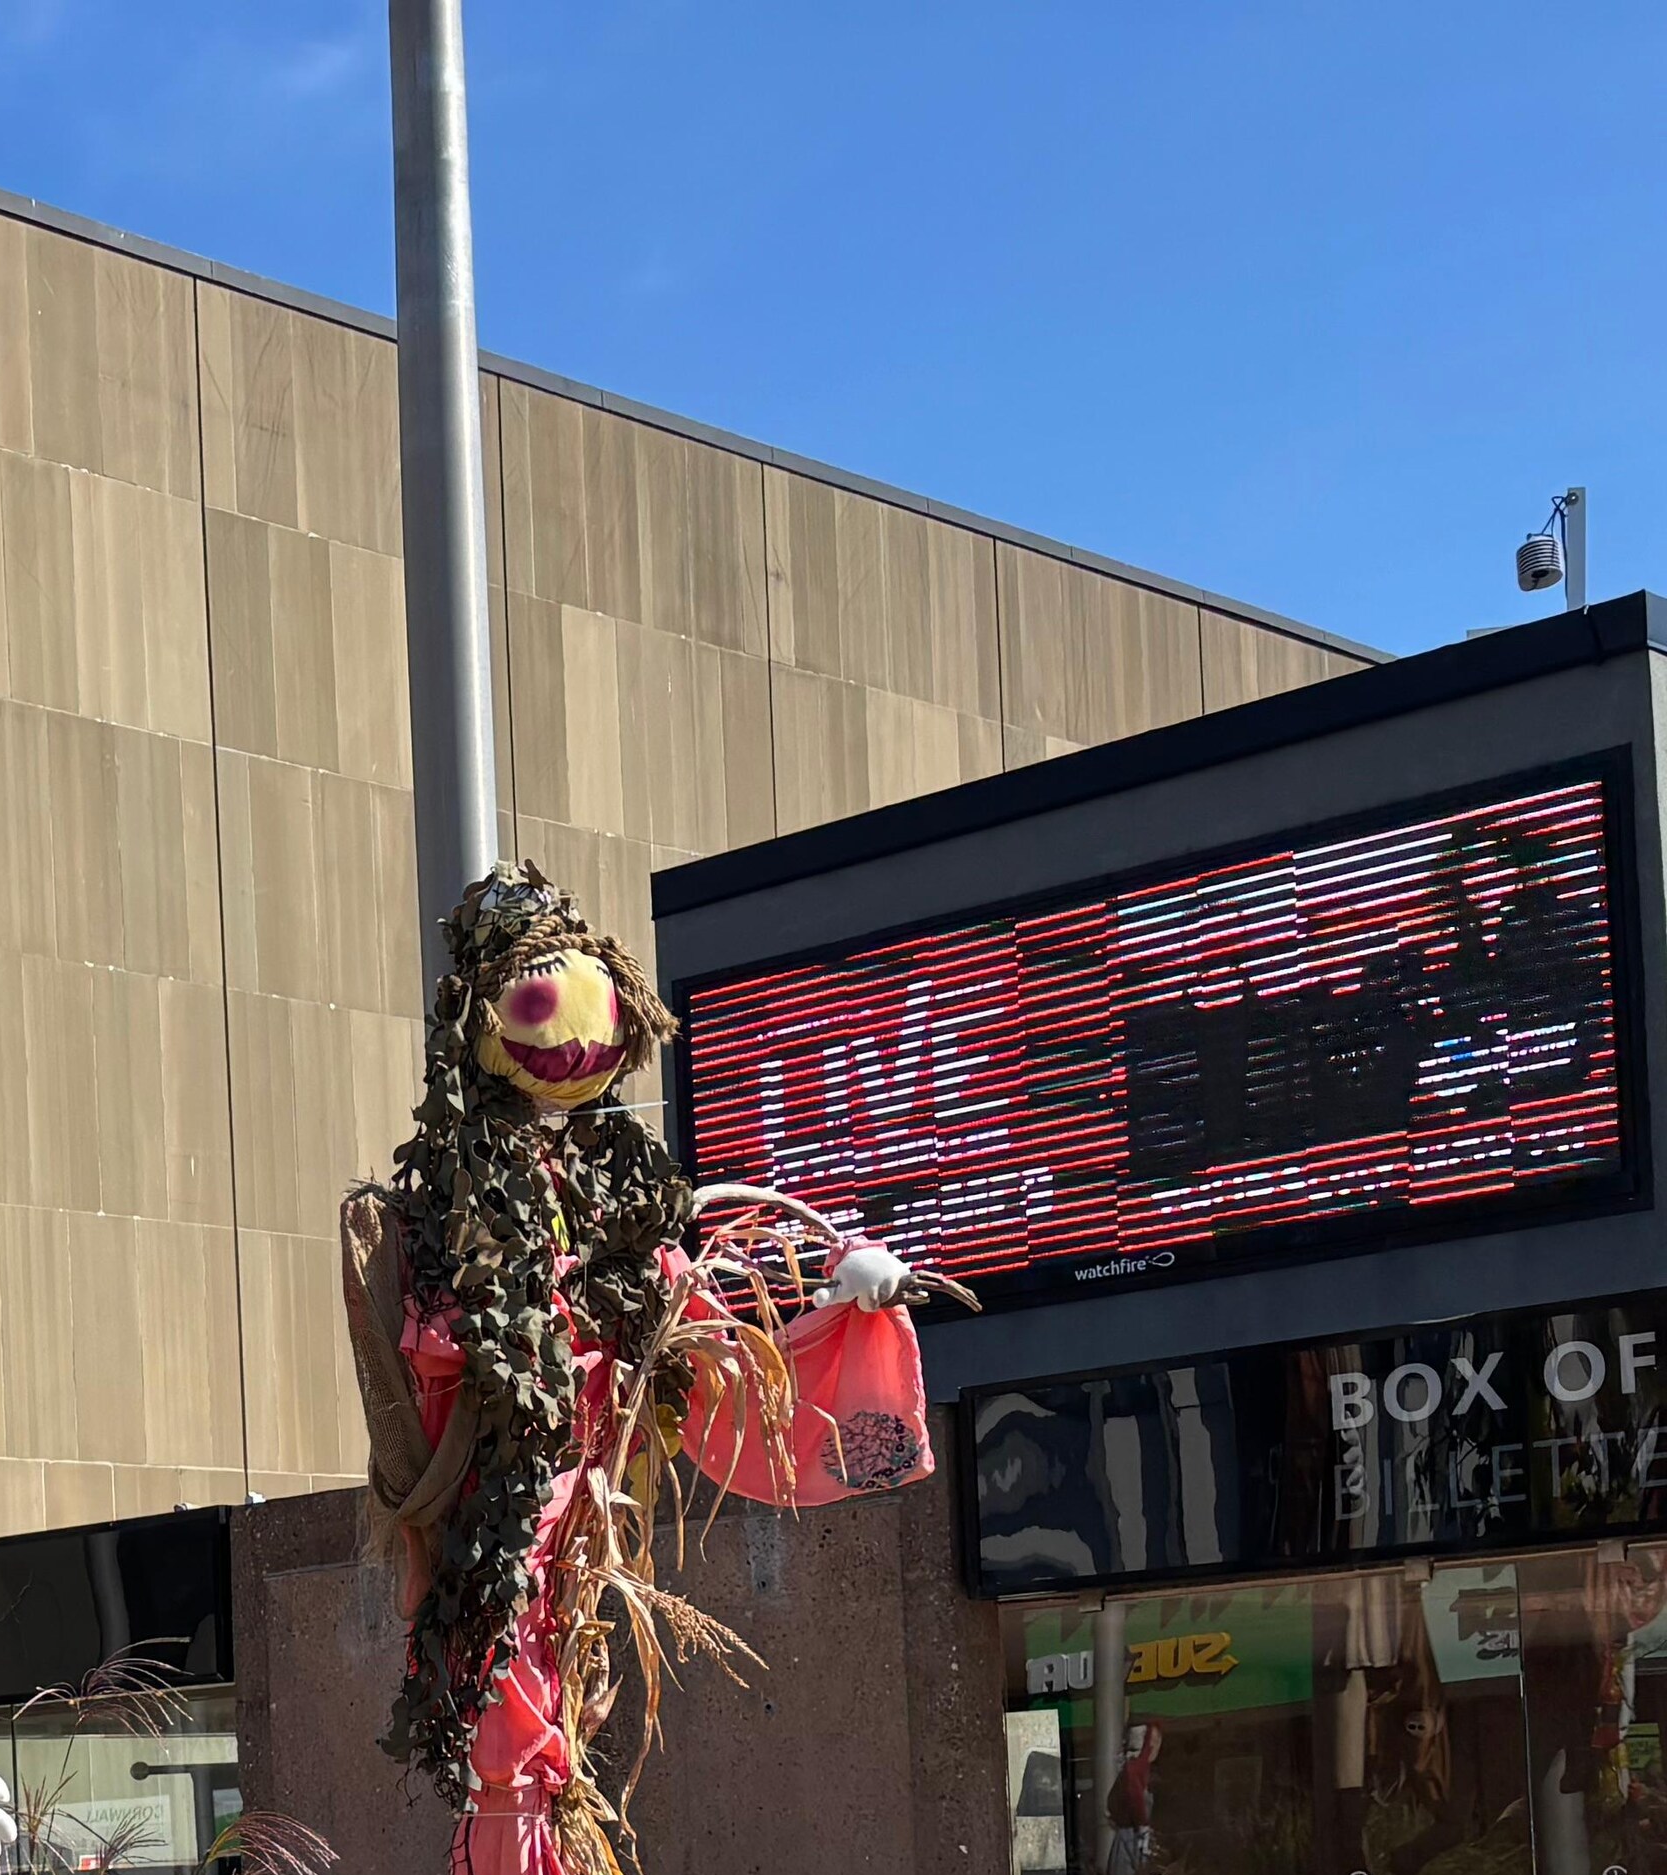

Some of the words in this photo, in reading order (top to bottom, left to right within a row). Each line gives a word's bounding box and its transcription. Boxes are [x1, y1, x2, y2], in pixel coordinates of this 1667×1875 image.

[1074, 1258, 1147, 1281] watchfire
[1329, 1351, 1508, 1431] BOX
[1543, 1331, 1657, 1402] OF
